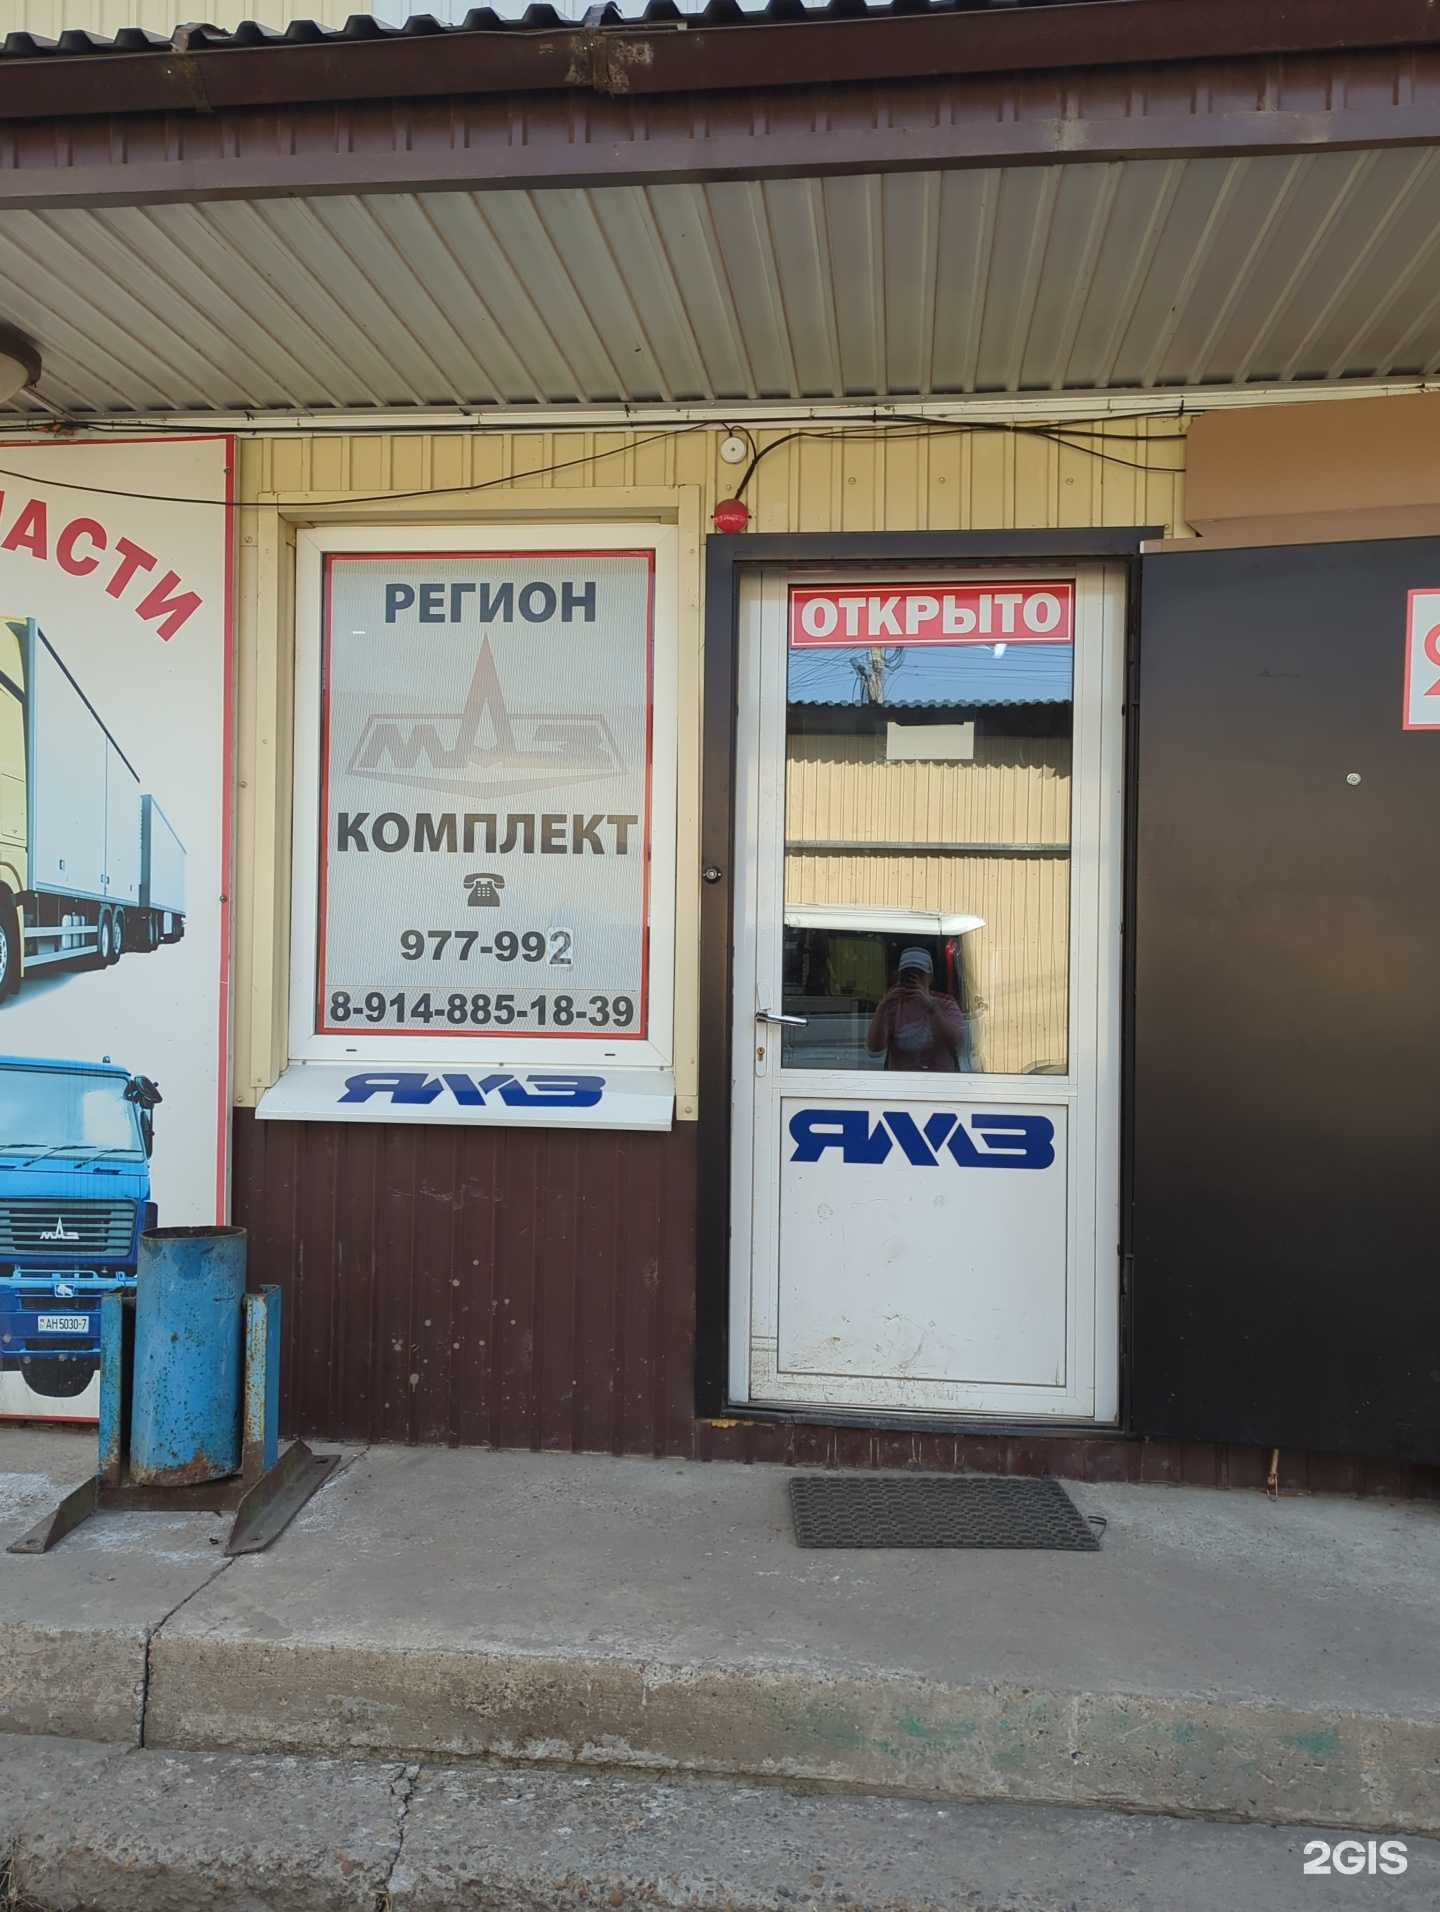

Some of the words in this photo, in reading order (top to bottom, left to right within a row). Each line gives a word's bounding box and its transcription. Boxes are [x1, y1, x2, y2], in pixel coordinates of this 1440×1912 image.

[0, 490, 203, 642] АСТИ
[385, 581, 596, 623] РЕГИОН
[801, 592, 1061, 638] ОТКРЫТО
[336, 812, 638, 855] КОМПЛЕКТ
[400, 929, 572, 965] 977-992
[330, 991, 634, 1027] 8-914-885-18-39
